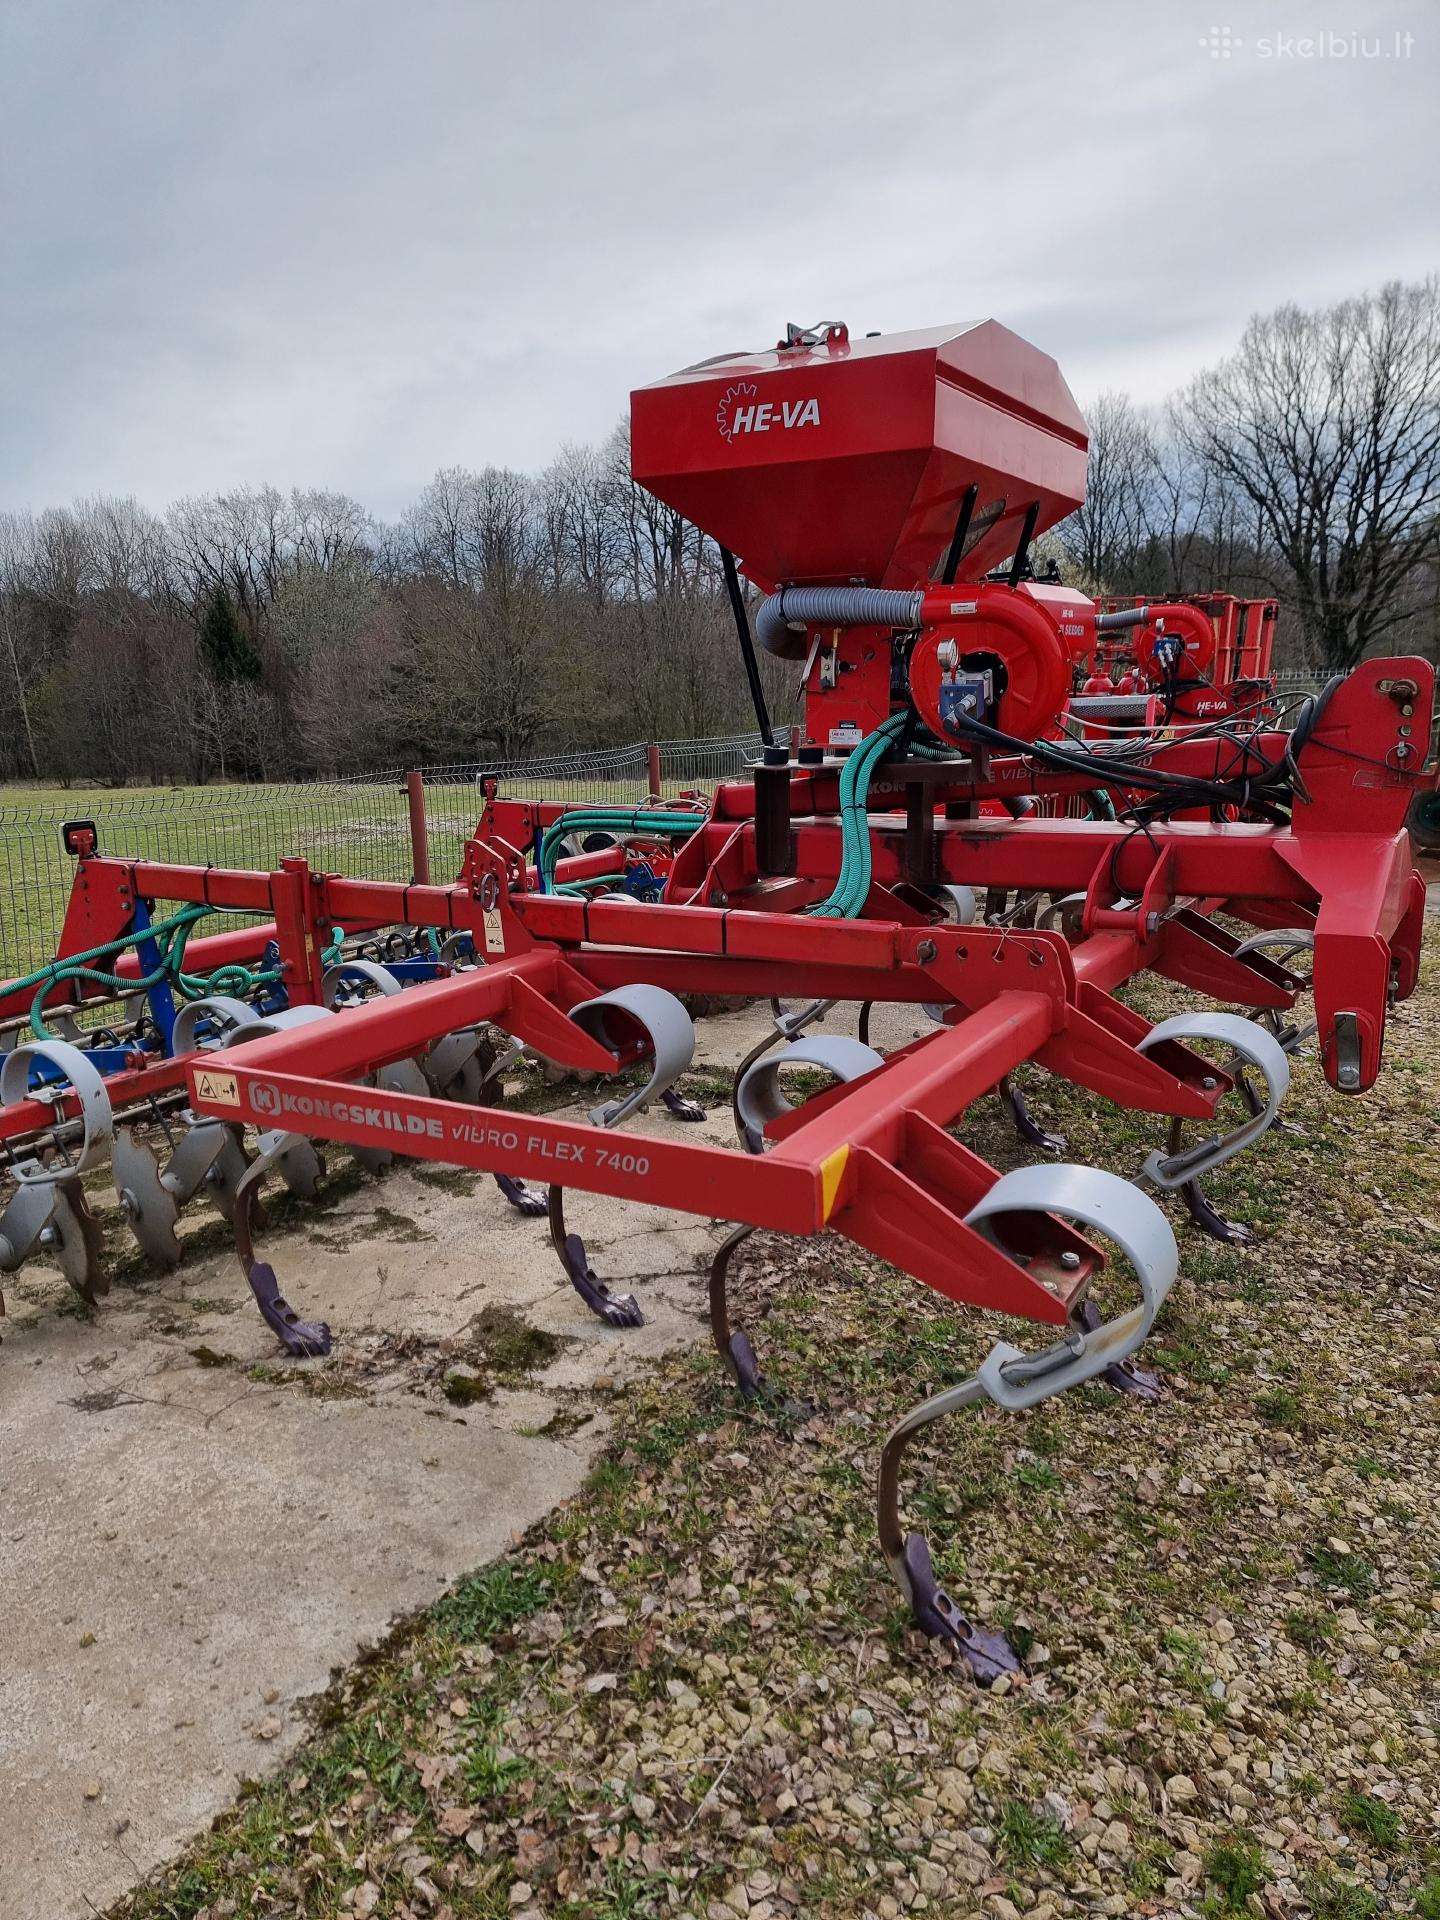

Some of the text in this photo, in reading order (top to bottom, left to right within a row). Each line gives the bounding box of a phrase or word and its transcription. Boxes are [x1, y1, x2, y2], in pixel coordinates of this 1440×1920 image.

[732, 398, 821, 434] HE-VA
[1196, 701, 1228, 711] HE-VA
[281, 1092, 444, 1139] KONGSKILDE
[452, 1124, 518, 1150] VIBRO
[527, 1135, 586, 1163] FLEX
[594, 1149, 650, 1176] 7400
